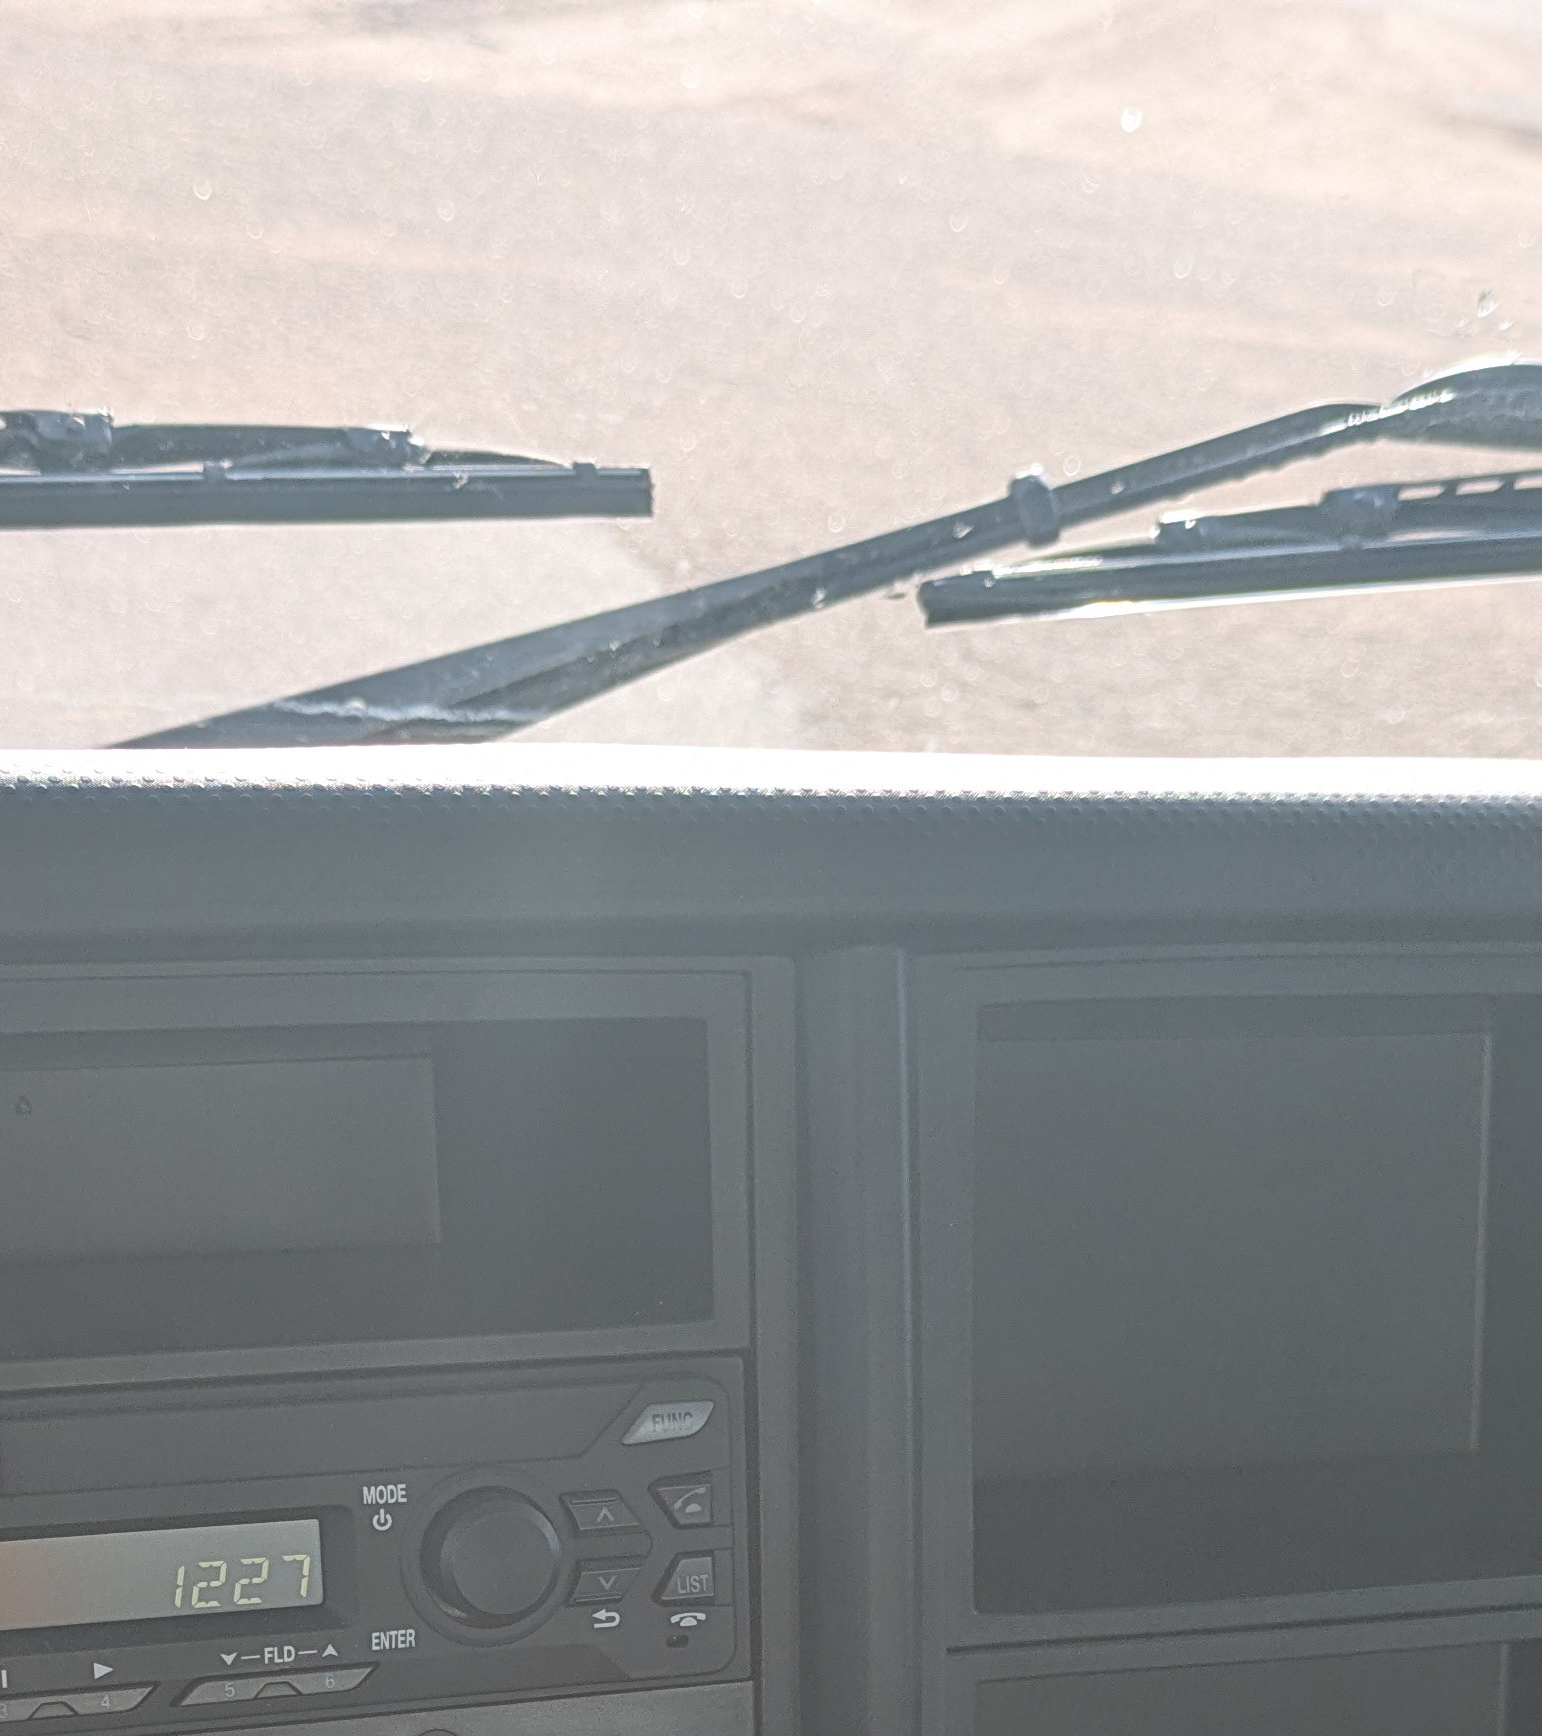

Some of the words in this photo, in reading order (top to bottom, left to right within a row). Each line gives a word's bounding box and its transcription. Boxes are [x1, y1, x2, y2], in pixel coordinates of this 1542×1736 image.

[652, 1410, 694, 1433] FUNC
[362, 1484, 408, 1504] MODE
[174, 1554, 311, 1608] 1227
[676, 1573, 709, 1595] LIST
[371, 1629, 416, 1651] ENTER
[263, 1645, 296, 1664] FLD
[224, 1681, 236, 1698] 5
[325, 1674, 335, 1689] 6
[100, 1694, 111, 1710] 4
